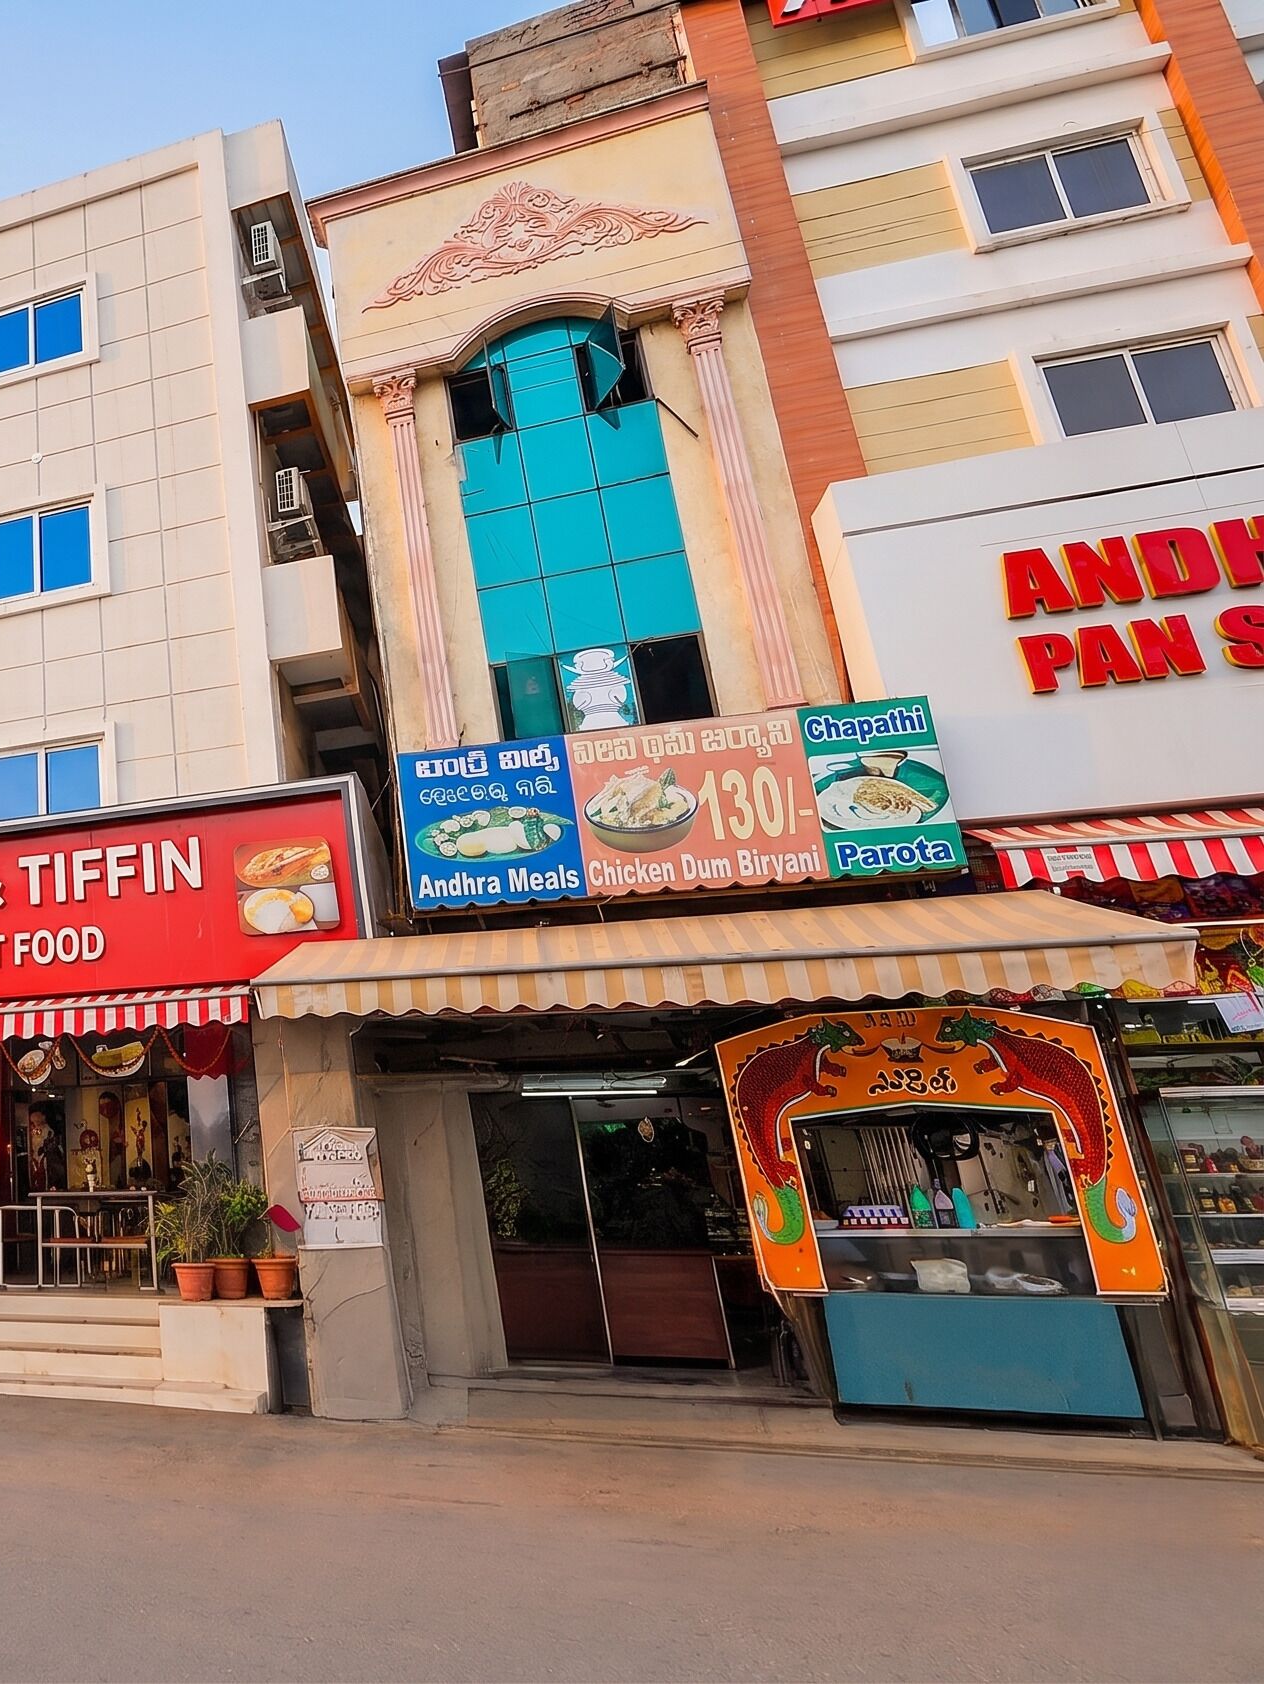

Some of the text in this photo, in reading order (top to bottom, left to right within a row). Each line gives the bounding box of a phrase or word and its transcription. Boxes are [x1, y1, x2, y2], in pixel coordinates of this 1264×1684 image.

[1015, 613, 1208, 695] PAN
[805, 706, 927, 744] Chapathi
[697, 765, 814, 841] 130/-
[17, 836, 202, 905] TIFFIN
[587, 844, 822, 887] Chicken Dum Biryani
[836, 836, 955, 869] Parota
[418, 864, 580, 899] Andhra Meals
[13, 926, 106, 966] FOOD
